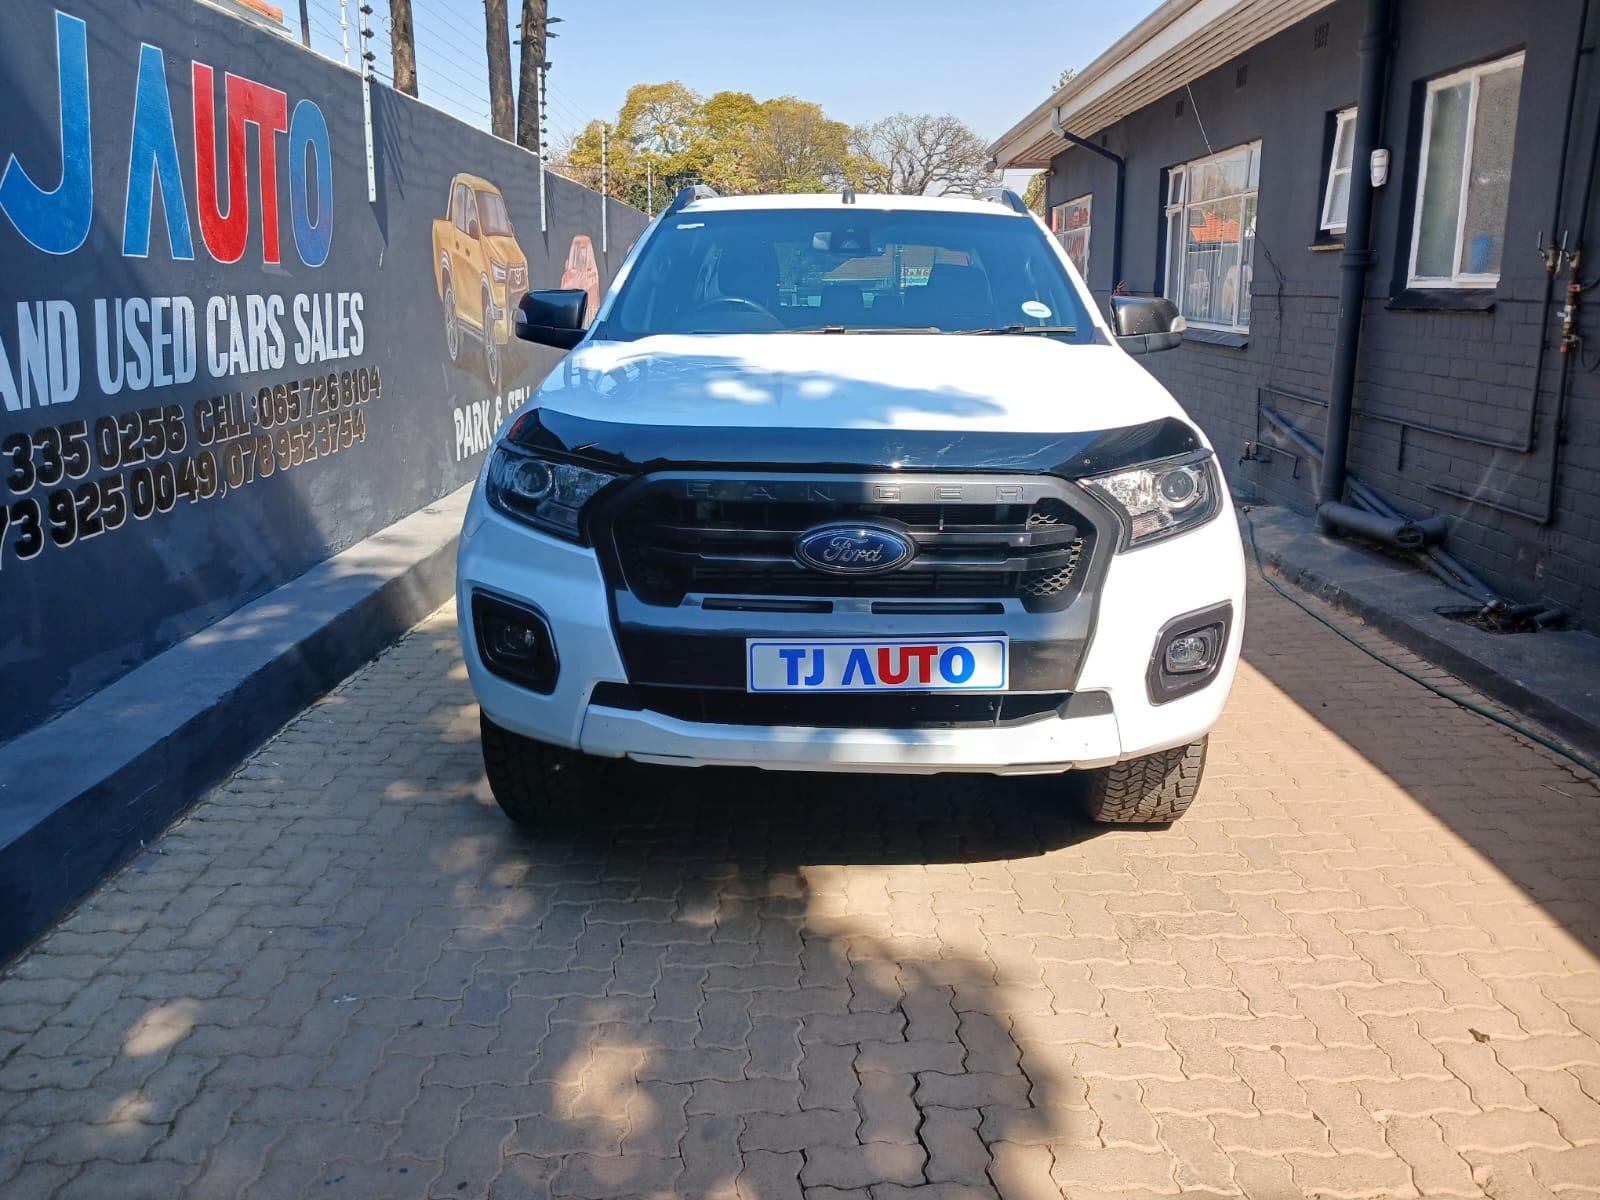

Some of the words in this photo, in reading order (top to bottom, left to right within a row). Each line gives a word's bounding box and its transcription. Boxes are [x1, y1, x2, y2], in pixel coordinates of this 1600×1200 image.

[122, 42, 333, 267] AUTO
[95, 296, 198, 395] USED
[206, 294, 286, 378] CARS
[293, 292, 365, 366] SALES
[2, 420, 91, 495] 335
[95, 404, 188, 472] 0256
[453, 399, 493, 462] PARK
[48, 473, 127, 548] 925
[686, 480, 1024, 502] RANGER
[823, 536, 884, 563] Ford
[779, 648, 825, 687] TJ
[841, 645, 976, 686] AUTO
